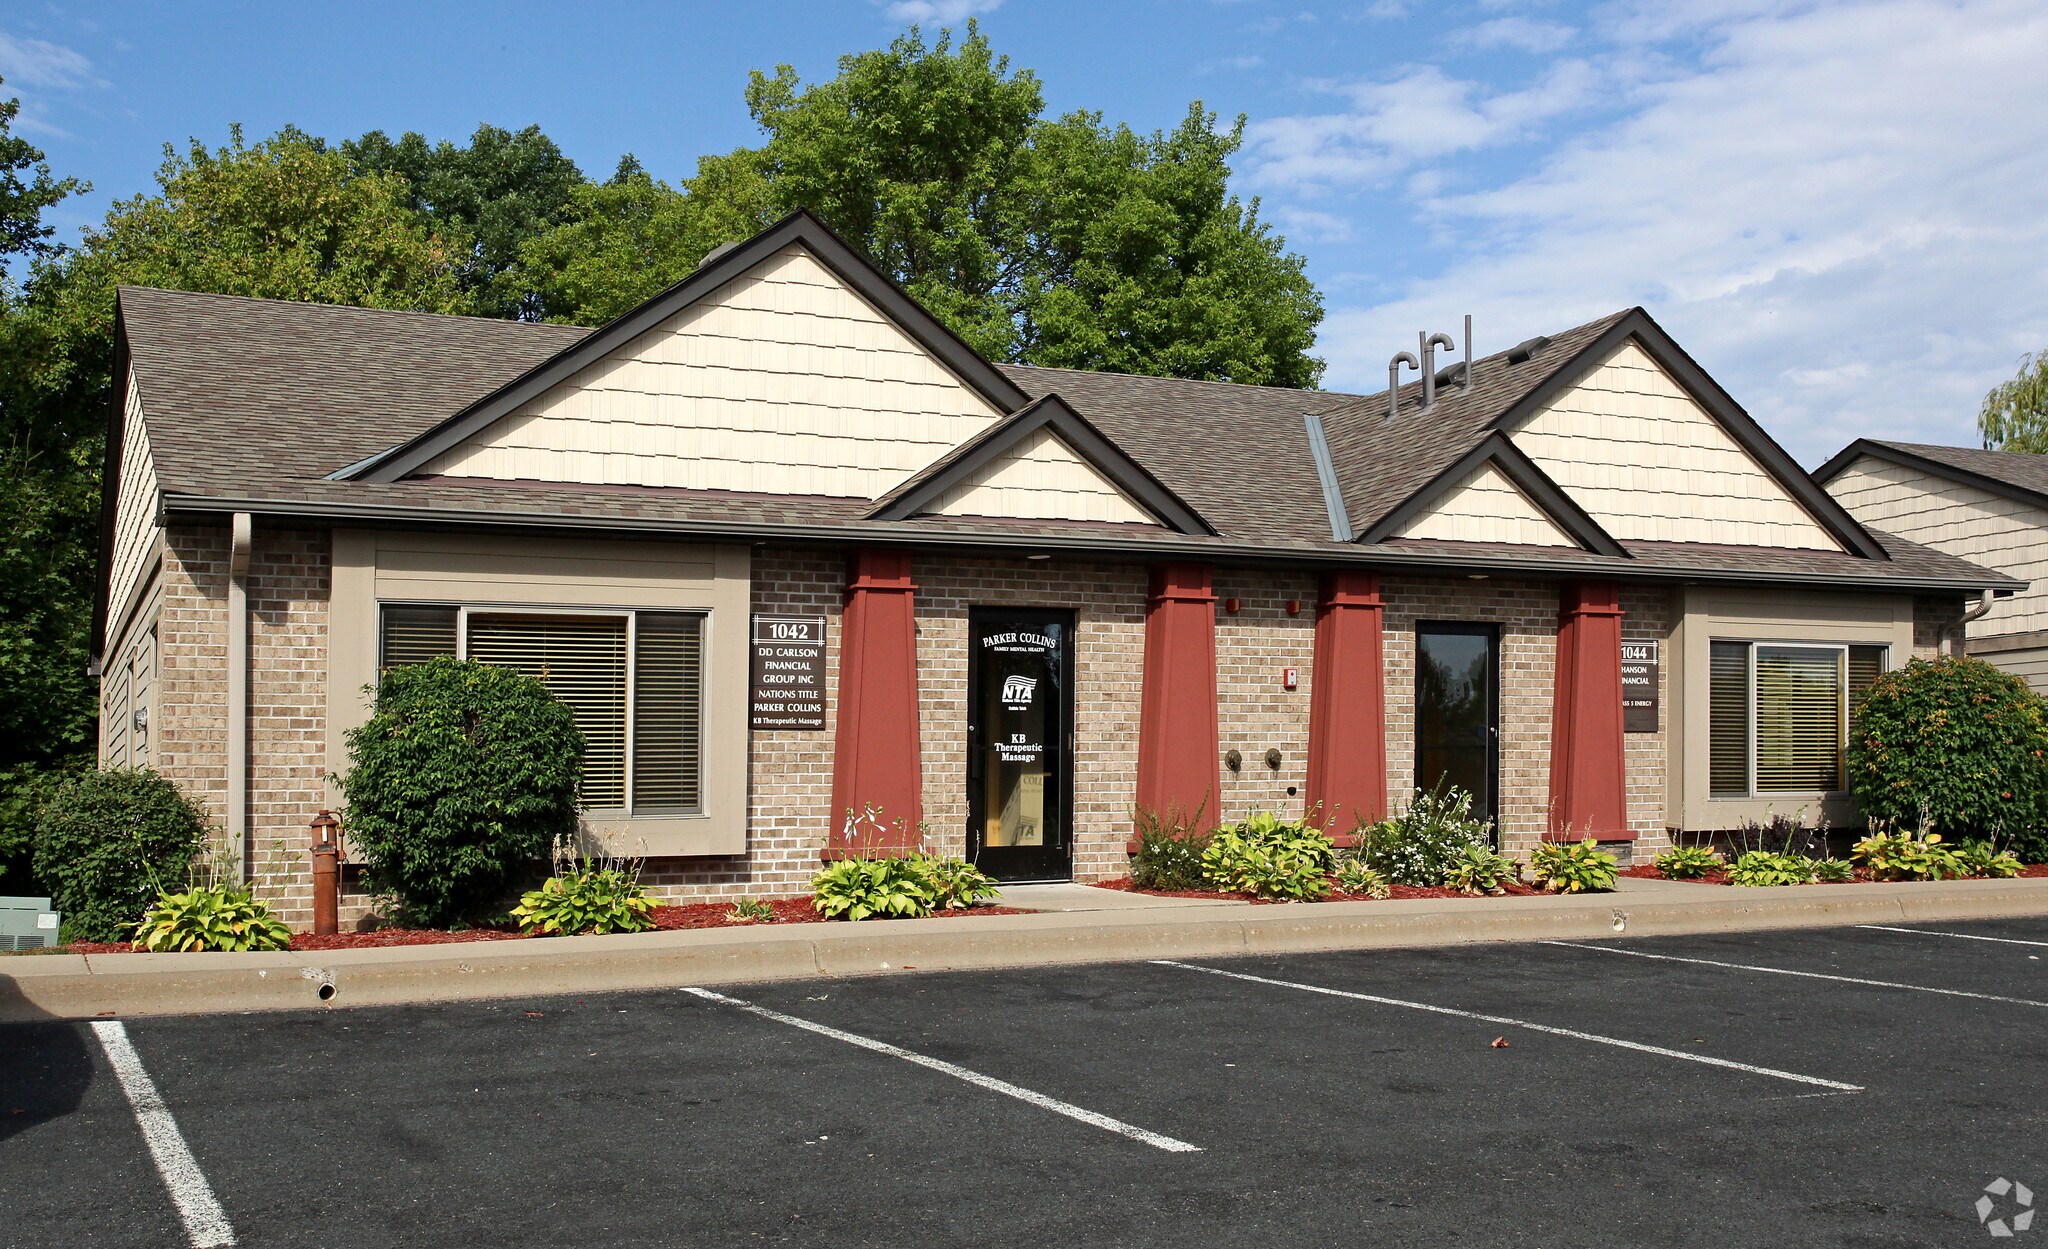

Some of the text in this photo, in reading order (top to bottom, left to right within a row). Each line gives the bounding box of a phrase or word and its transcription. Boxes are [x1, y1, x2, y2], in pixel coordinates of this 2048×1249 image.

[769, 623, 808, 639] 1042
[982, 632, 1056, 649] PARKER COLLINS
[758, 647, 818, 657] DD CARLSON
[1620, 646, 1647, 659] 1044
[764, 661, 812, 671] FINANCIAL
[762, 674, 814, 684] GROUP INC
[758, 690, 819, 699] NATIONS TITLE
[1002, 685, 1032, 699] NTA
[753, 703, 822, 712] PARKER COLLINS
[762, 717, 797, 726] Therapeutic
[797, 718, 822, 726] Massage
[1011, 733, 1026, 744] KB
[994, 742, 1043, 753] Therapeutic
[1001, 752, 1036, 763] Massage
